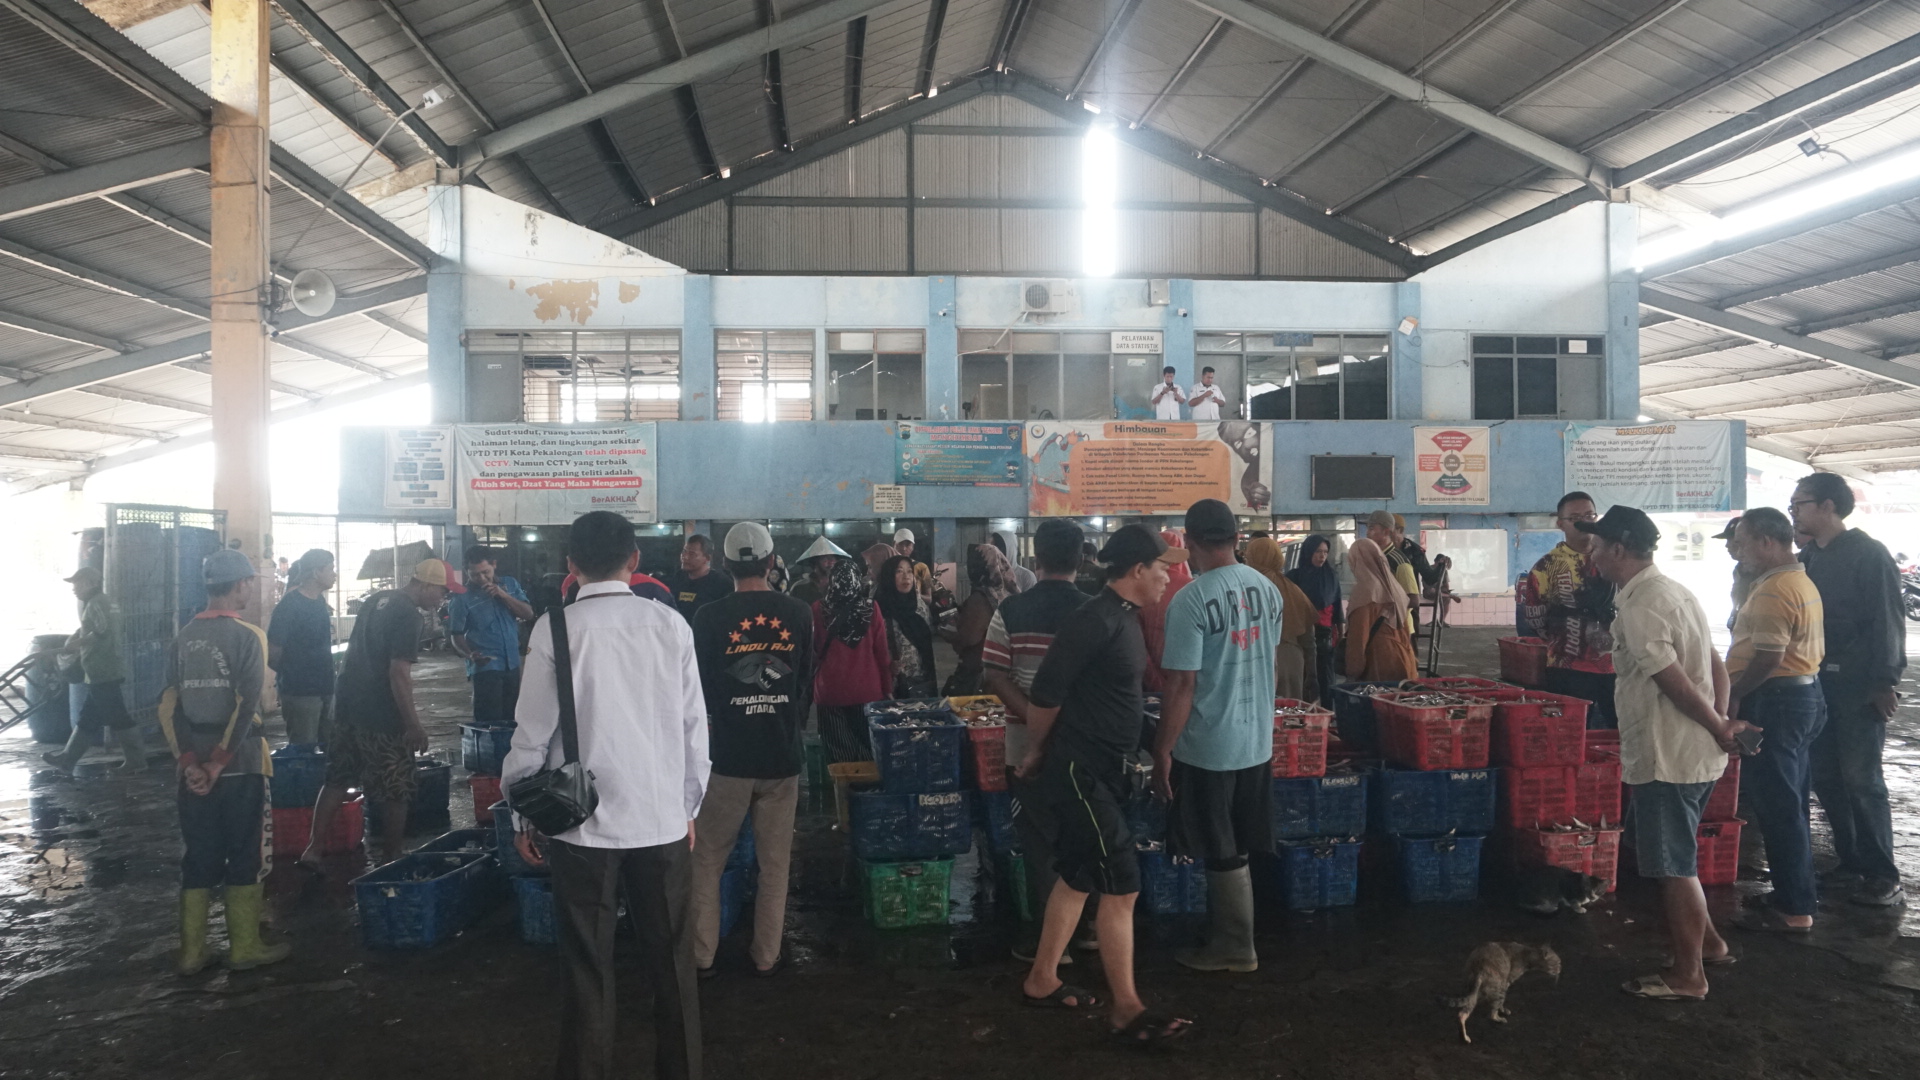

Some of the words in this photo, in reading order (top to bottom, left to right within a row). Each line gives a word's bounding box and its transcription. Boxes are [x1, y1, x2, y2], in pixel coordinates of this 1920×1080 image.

[1115, 425, 1166, 433] Himbauan
[1615, 425, 1676, 435] MAKLUMAT
[510, 439, 539, 447] lelang,
[559, 439, 607, 447] lingkungan
[533, 449, 583, 457] Pekalongan
[608, 448, 646, 456] dipasang
[552, 470, 579, 478] paling
[544, 480, 565, 488] Yang
[592, 479, 639, 488] Mengawasi
[591, 495, 637, 503] BerAKHLAK
[1565, 616, 1581, 656] RPATI
[725, 643, 768, 655] LINDU
[770, 643, 795, 652] AJI
[730, 695, 789, 705] PEKALONGAN
[745, 704, 776, 715] UTARA
